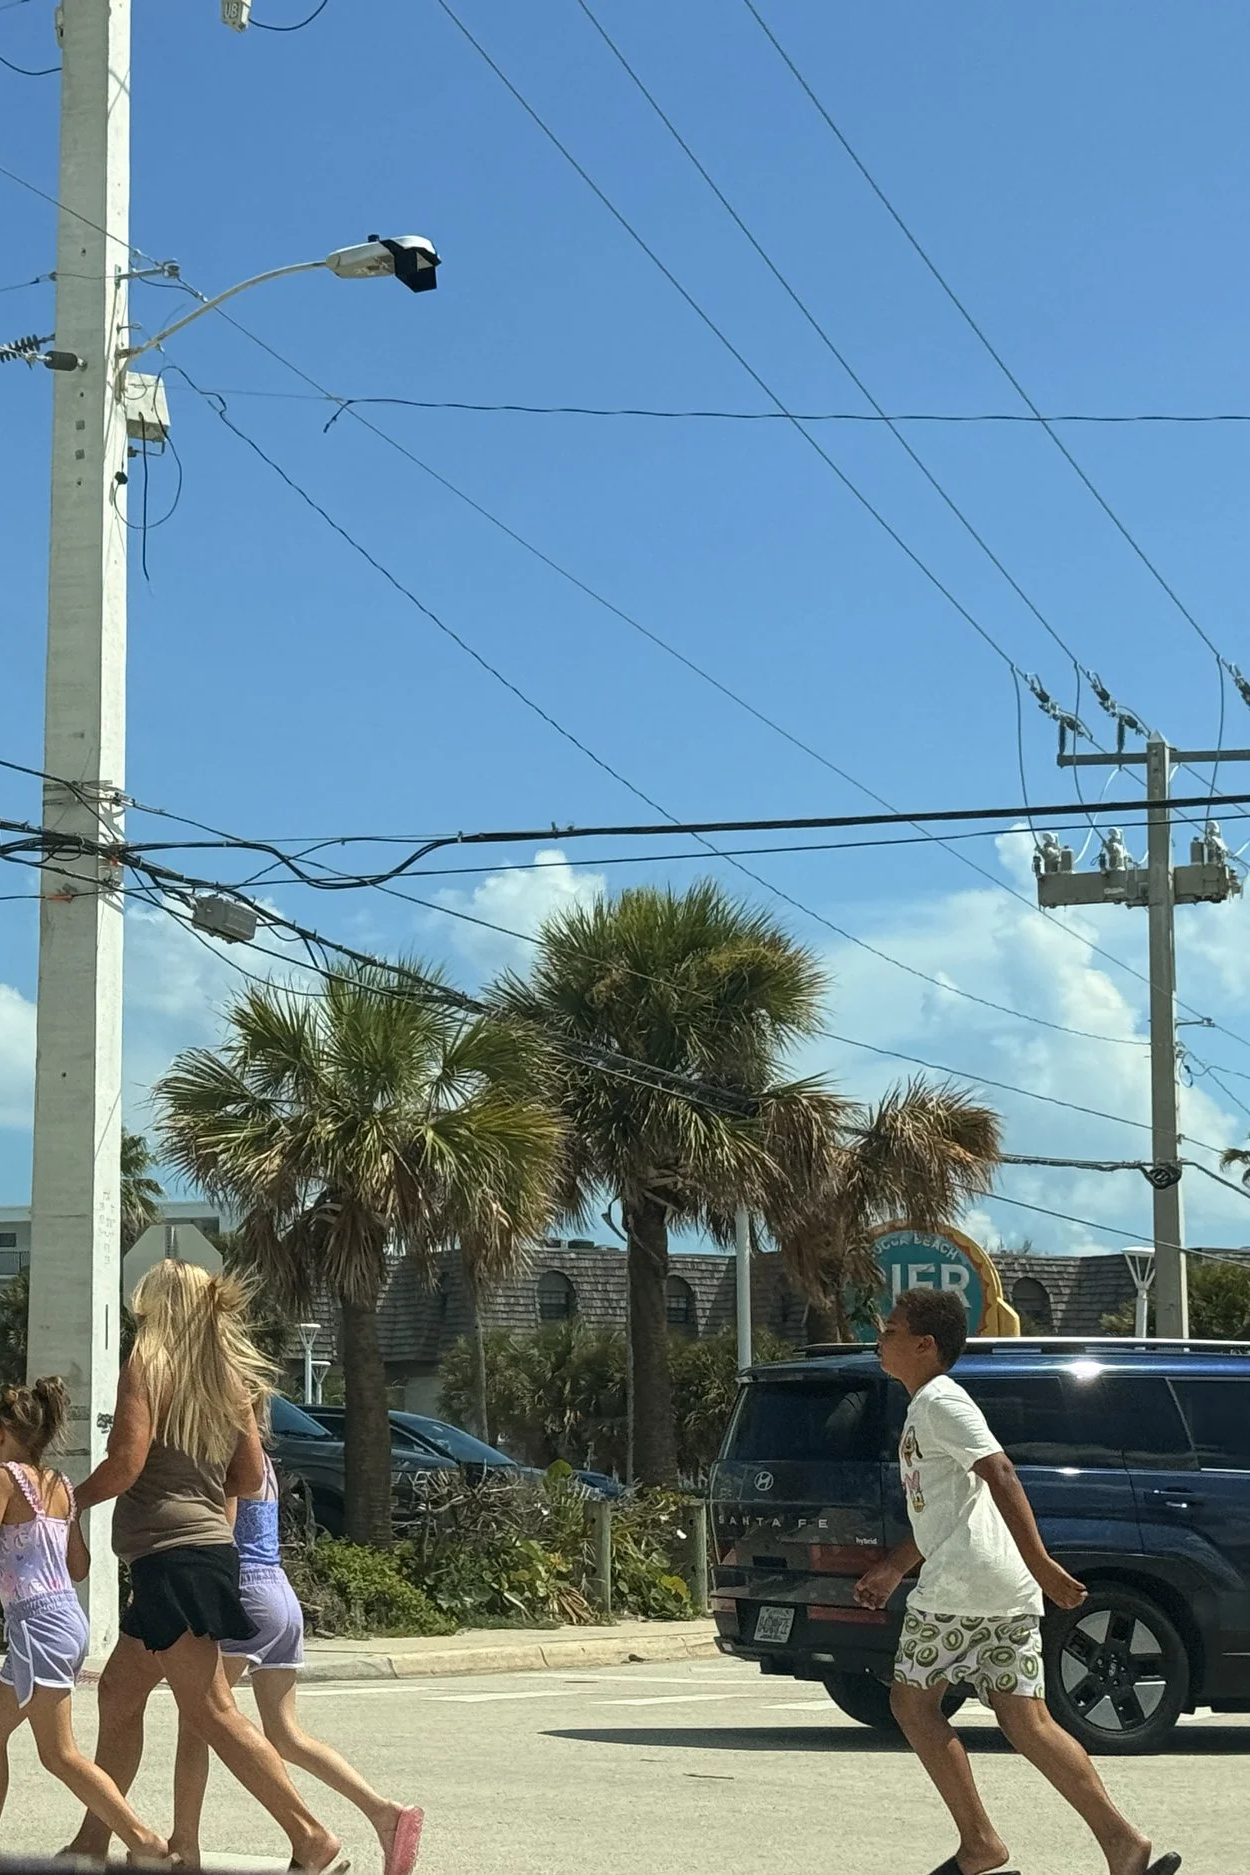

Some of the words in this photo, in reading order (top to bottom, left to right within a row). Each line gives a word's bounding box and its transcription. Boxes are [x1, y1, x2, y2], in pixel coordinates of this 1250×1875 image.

[891, 1264, 971, 1308] IER
[718, 1515, 782, 1528] SANTA
[797, 1518, 829, 1529] FE
[855, 1536, 878, 1546] hybrid
